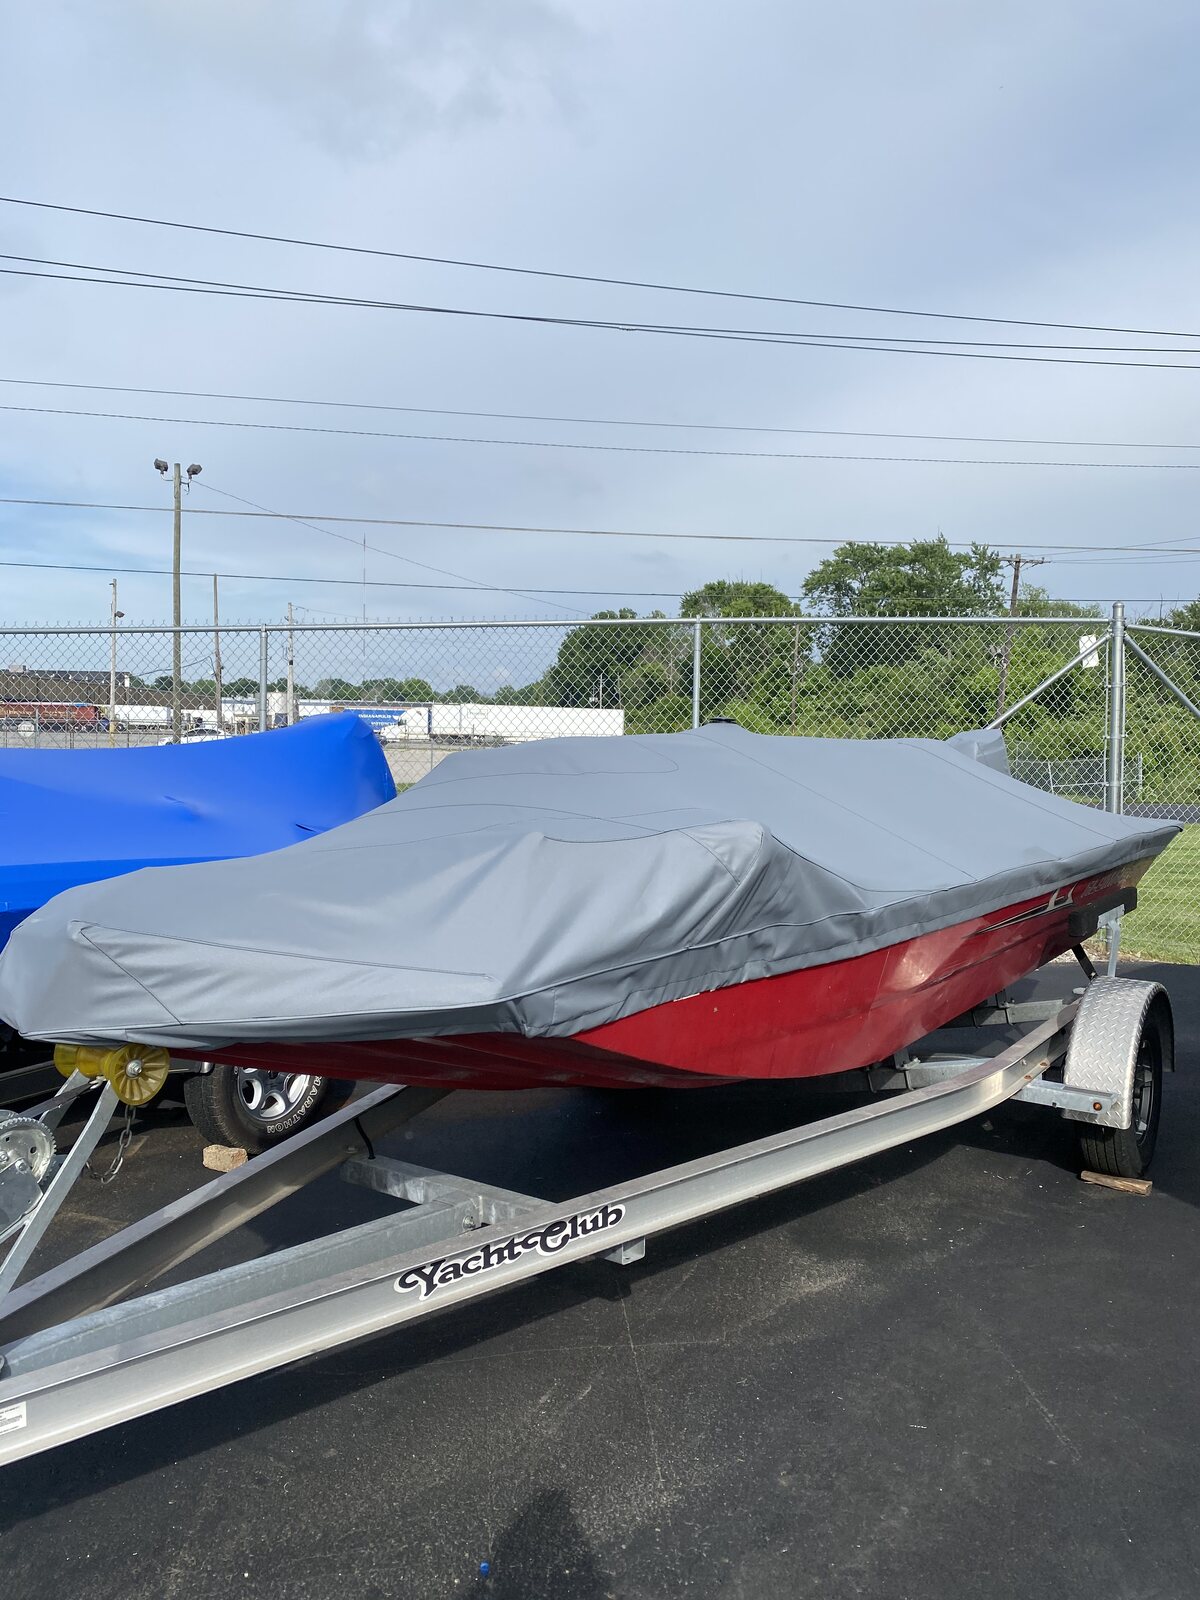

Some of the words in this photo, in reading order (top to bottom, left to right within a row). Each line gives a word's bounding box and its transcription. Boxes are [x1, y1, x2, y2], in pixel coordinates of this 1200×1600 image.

[267, 1075, 323, 1134] MARATHON
[398, 1237, 522, 1297] Yacht
[521, 1205, 623, 1253] Club
